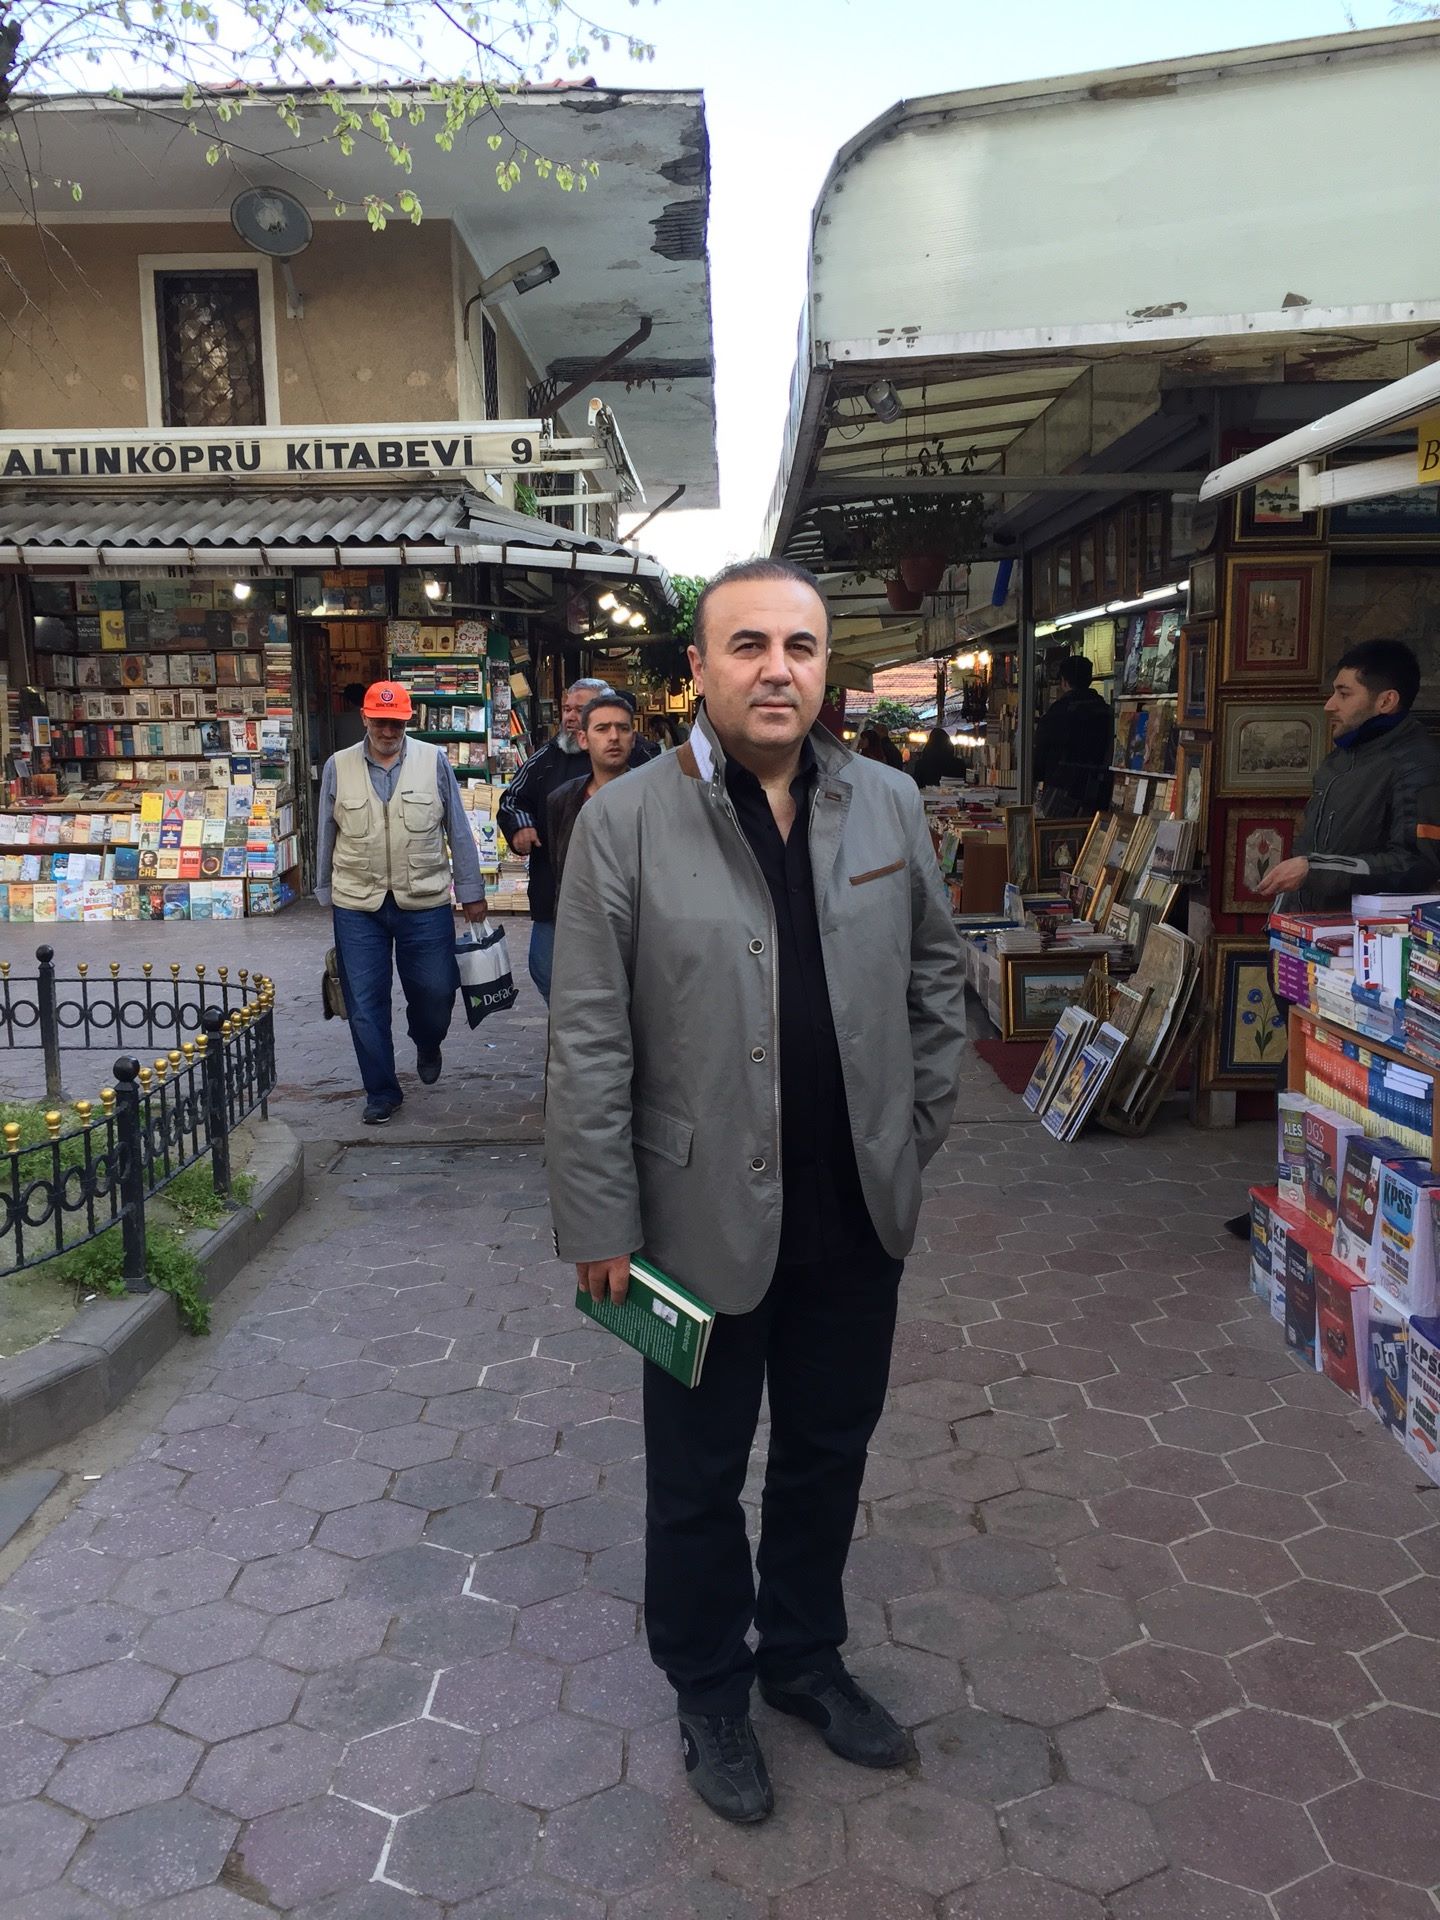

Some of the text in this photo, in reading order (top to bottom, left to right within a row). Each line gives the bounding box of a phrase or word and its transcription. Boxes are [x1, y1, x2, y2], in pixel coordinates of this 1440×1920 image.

[2, 435, 533, 476] ALTINKÖPRÜ KİTABEVİ 9
[139, 868, 157, 877] CHE
[1284, 1122, 1303, 1137] ALES
[1306, 1118, 1325, 1143] DGS
[1384, 1180, 1412, 1219] KPSS
[1410, 1338, 1440, 1379] KPS
